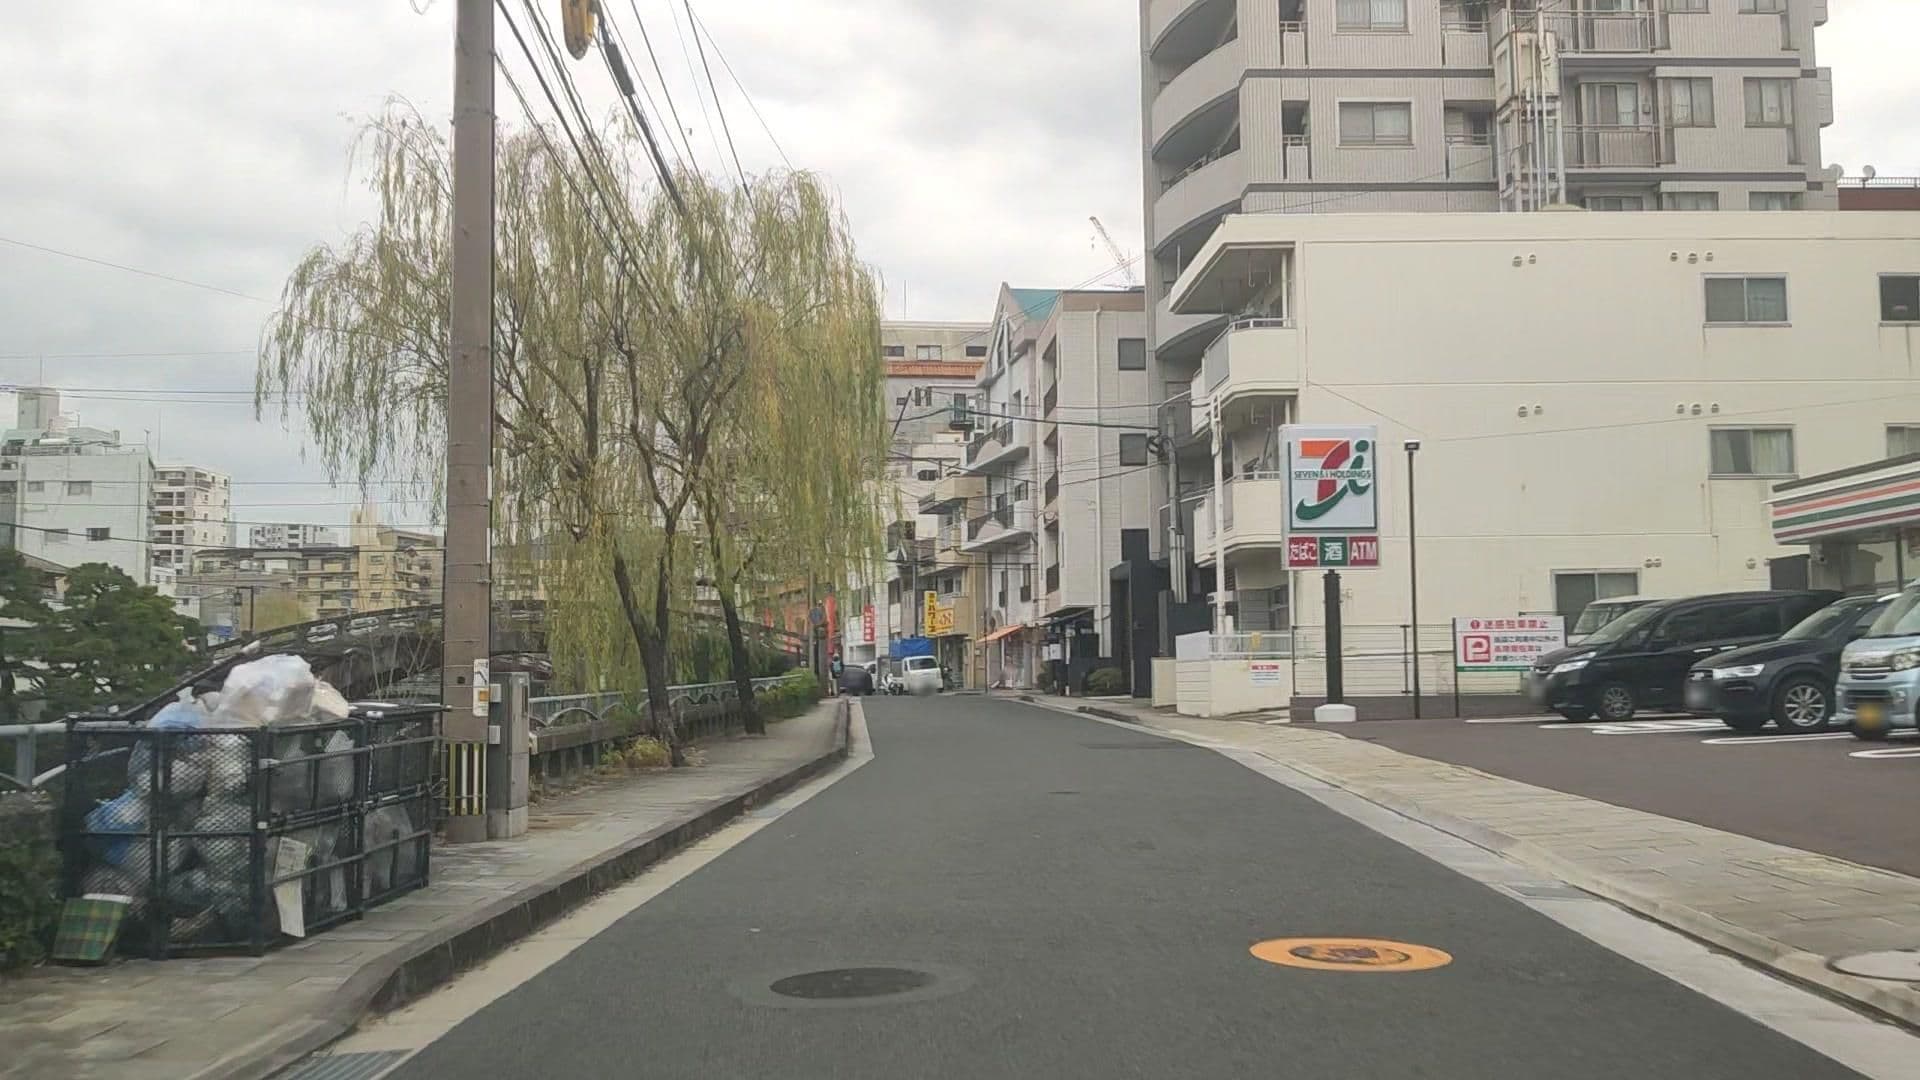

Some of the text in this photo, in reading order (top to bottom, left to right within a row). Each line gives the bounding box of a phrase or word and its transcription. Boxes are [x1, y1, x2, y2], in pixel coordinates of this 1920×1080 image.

[1289, 542, 1317, 561] たばこ
[1324, 542, 1343, 561] 酒
[1351, 541, 1377, 560] ATM
